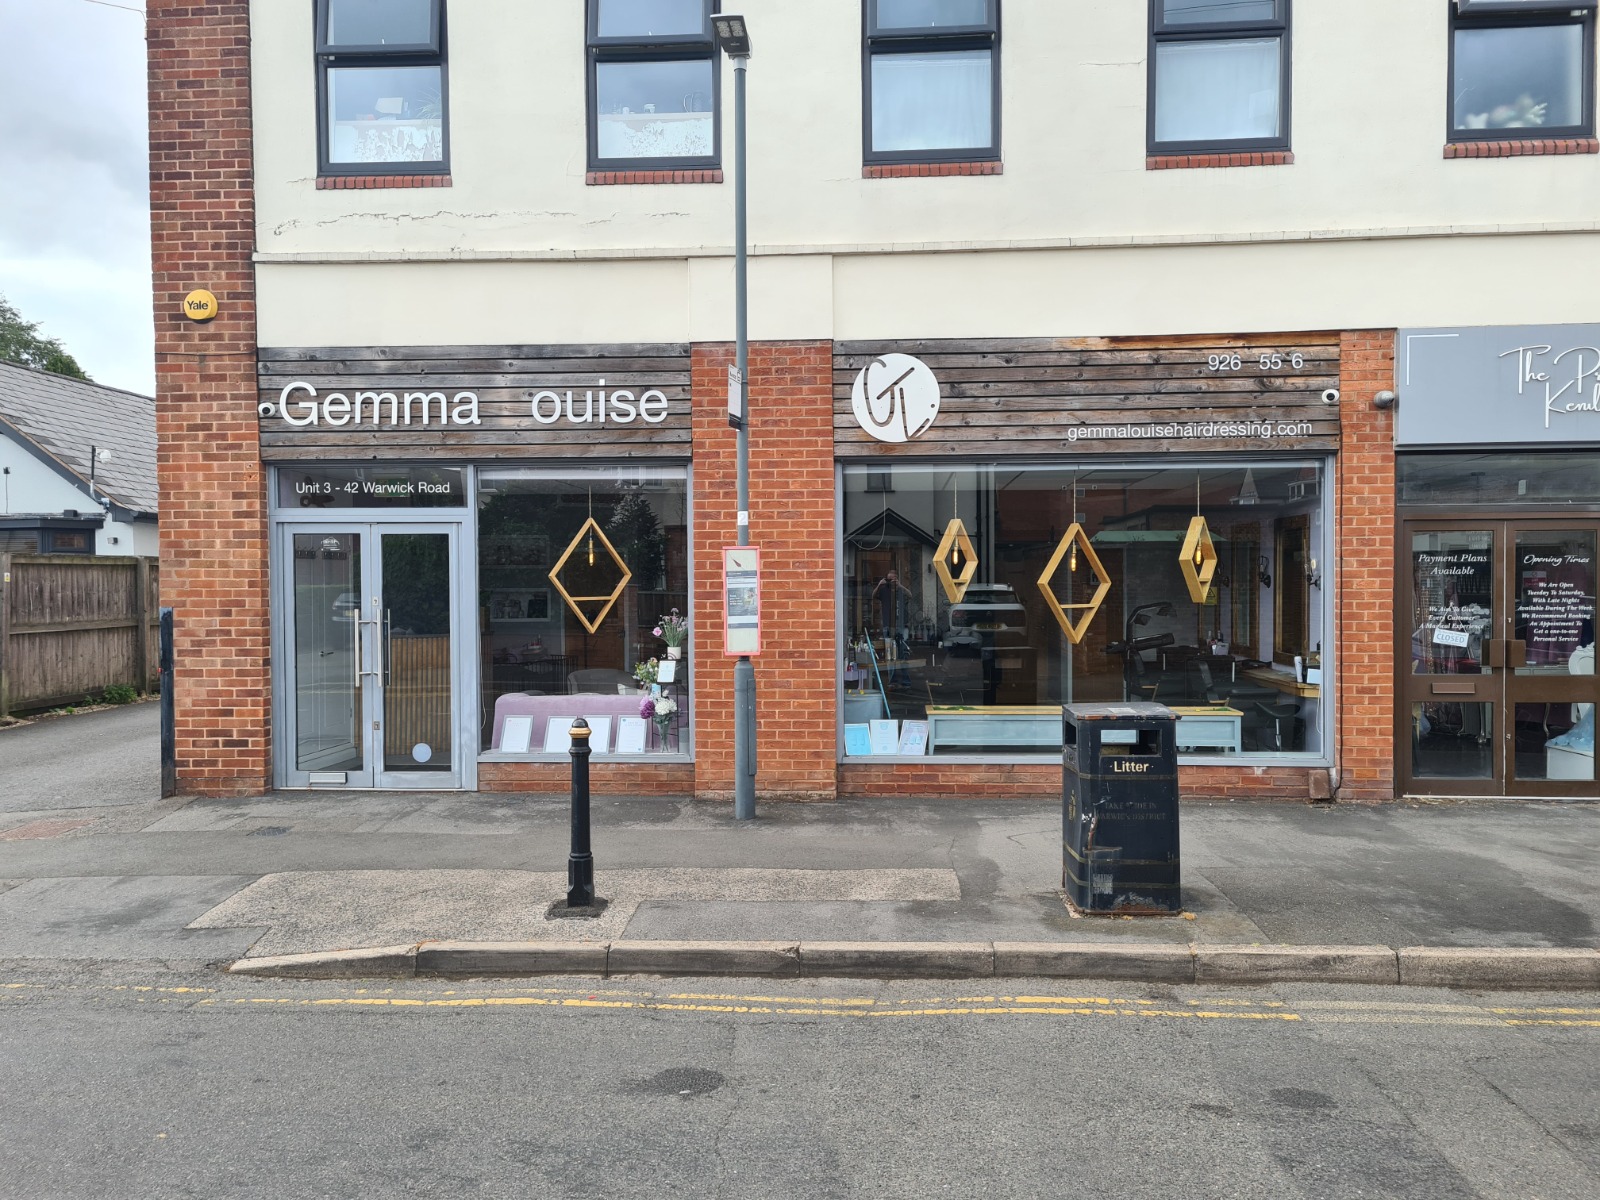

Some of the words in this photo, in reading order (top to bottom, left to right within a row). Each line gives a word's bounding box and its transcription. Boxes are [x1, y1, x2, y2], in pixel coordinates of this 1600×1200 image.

[187, 300, 209, 310] Yale
[1208, 354, 1242, 371] 926
[1498, 344, 1552, 394] The
[279, 381, 481, 426] Gemma
[531, 378, 668, 424] ouise
[1067, 422, 1313, 442] gemmalouisehairdressing.com
[295, 482, 320, 494] Unit
[323, 482, 332, 494] 3
[344, 482, 359, 494] 42
[362, 482, 414, 494] Warwick
[418, 482, 450, 494] Road
[1418, 554, 1458, 565] Payment
[1460, 554, 1488, 562] Plans
[1523, 554, 1563, 567] Opening
[1564, 554, 1590, 564] Times
[1430, 566, 1475, 575] Available
[1436, 633, 1465, 643] CLOSED
[1113, 760, 1150, 773] Litter
